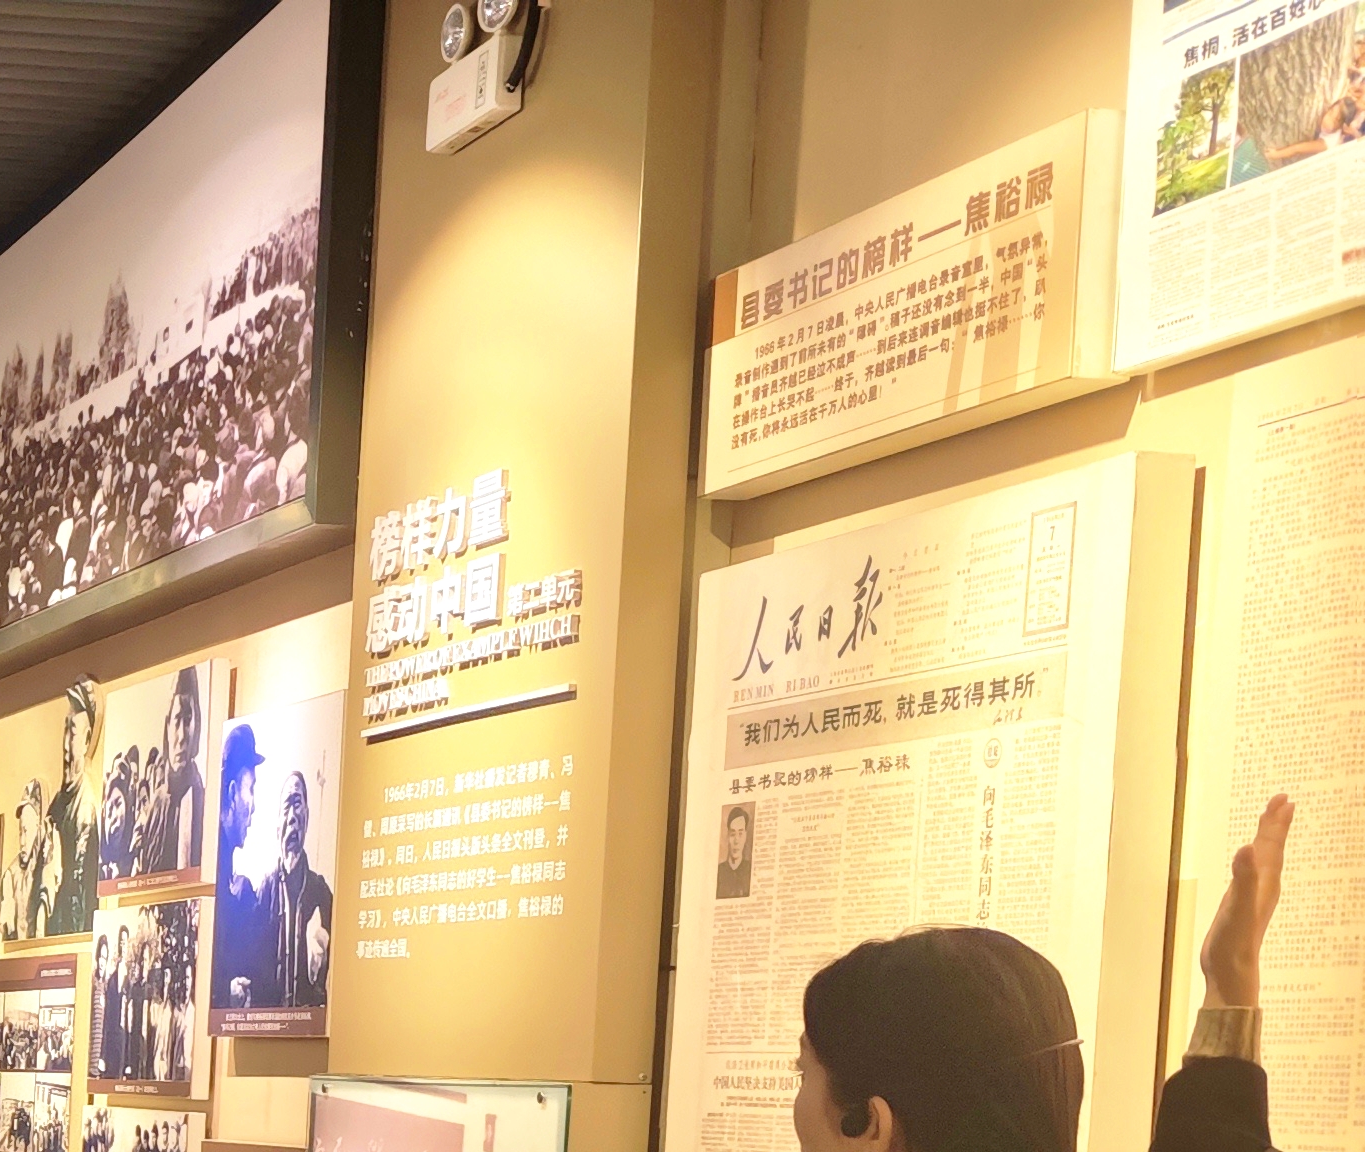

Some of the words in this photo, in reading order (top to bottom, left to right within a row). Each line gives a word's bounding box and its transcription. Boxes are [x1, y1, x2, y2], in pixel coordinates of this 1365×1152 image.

[740, 161, 1054, 330] 县委书记的榜样——焦裕禄
[369, 468, 509, 584] 榜样力量
[365, 553, 503, 656] 感动中国
